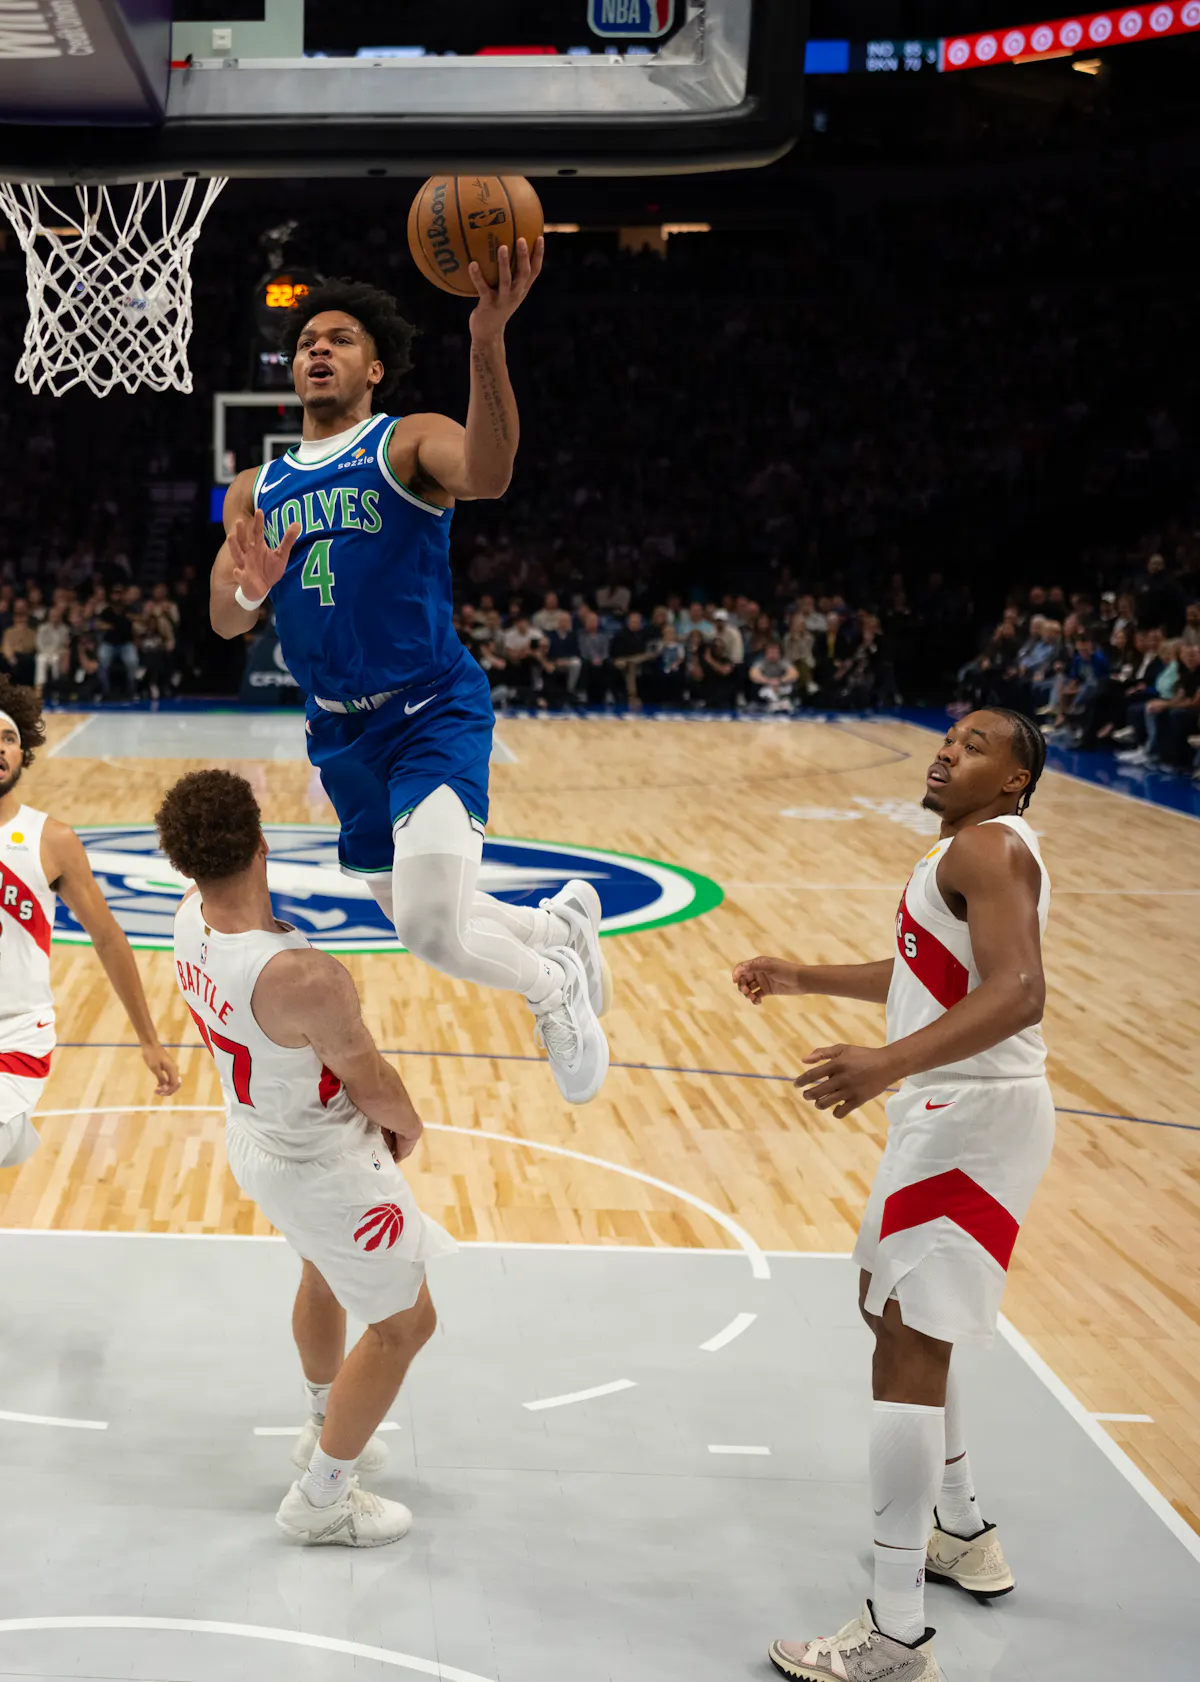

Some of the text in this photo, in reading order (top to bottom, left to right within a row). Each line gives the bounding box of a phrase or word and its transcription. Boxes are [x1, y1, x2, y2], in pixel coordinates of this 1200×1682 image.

[601, 0, 641, 24] NBA
[427, 182, 460, 276] Wilson
[337, 456, 374, 470] sezzle
[263, 487, 382, 552] WOLVES
[301, 538, 336, 607] 4
[176, 959, 235, 1026] BATTLE
